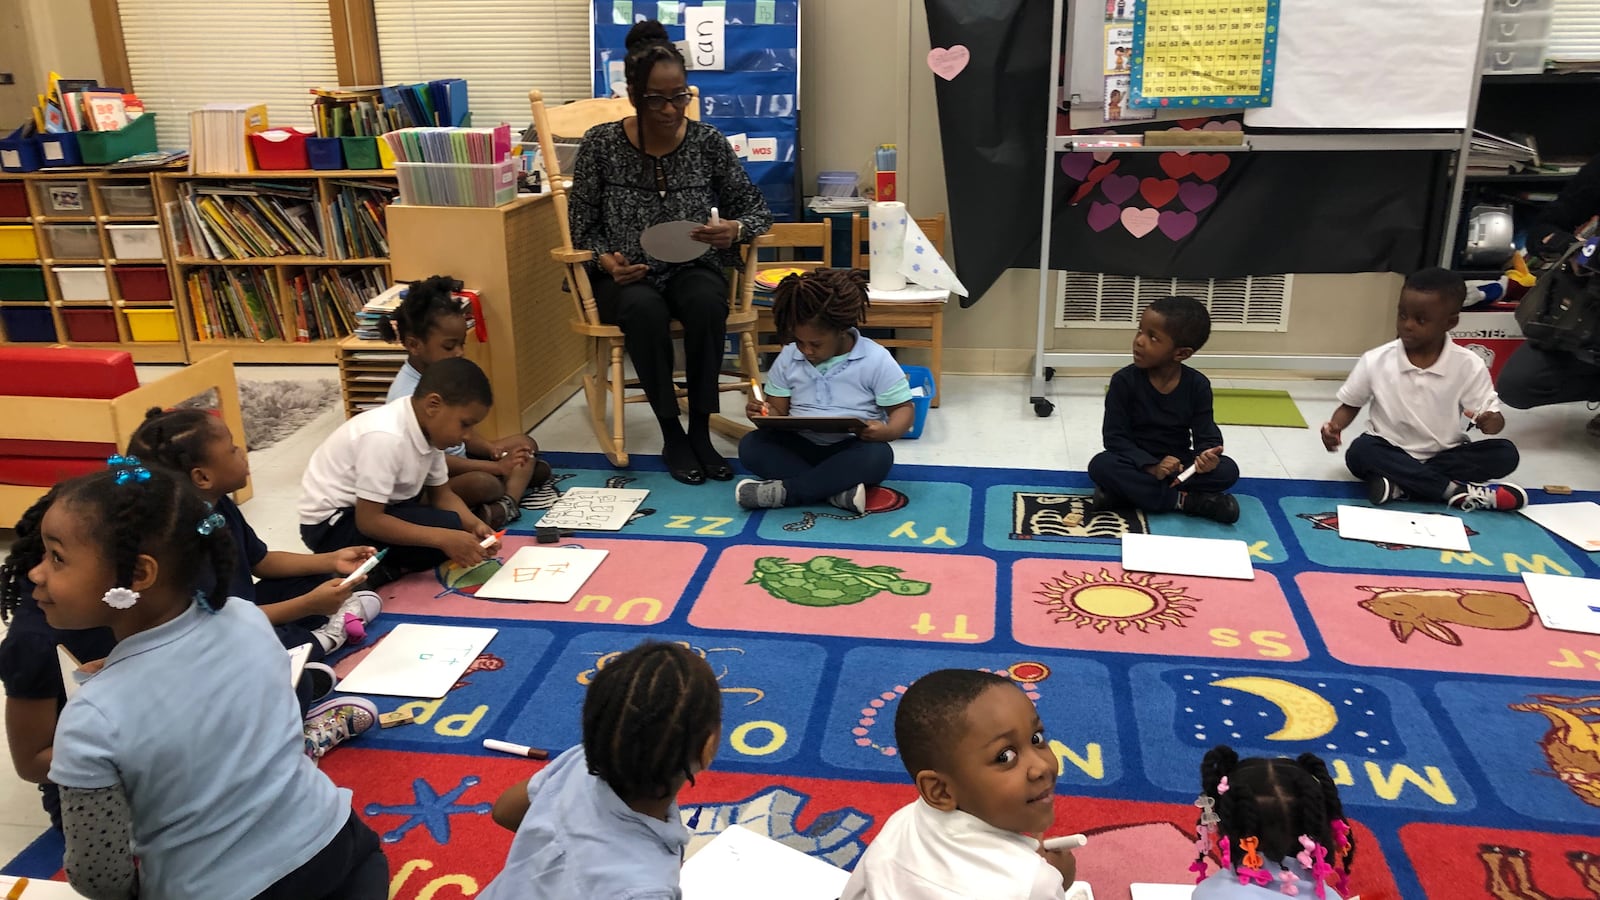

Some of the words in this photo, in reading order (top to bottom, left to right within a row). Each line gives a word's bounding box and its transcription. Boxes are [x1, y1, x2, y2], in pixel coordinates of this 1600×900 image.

[696, 21, 715, 66] can
[752, 147, 772, 155] was
[1208, 627, 1292, 657] Ss
